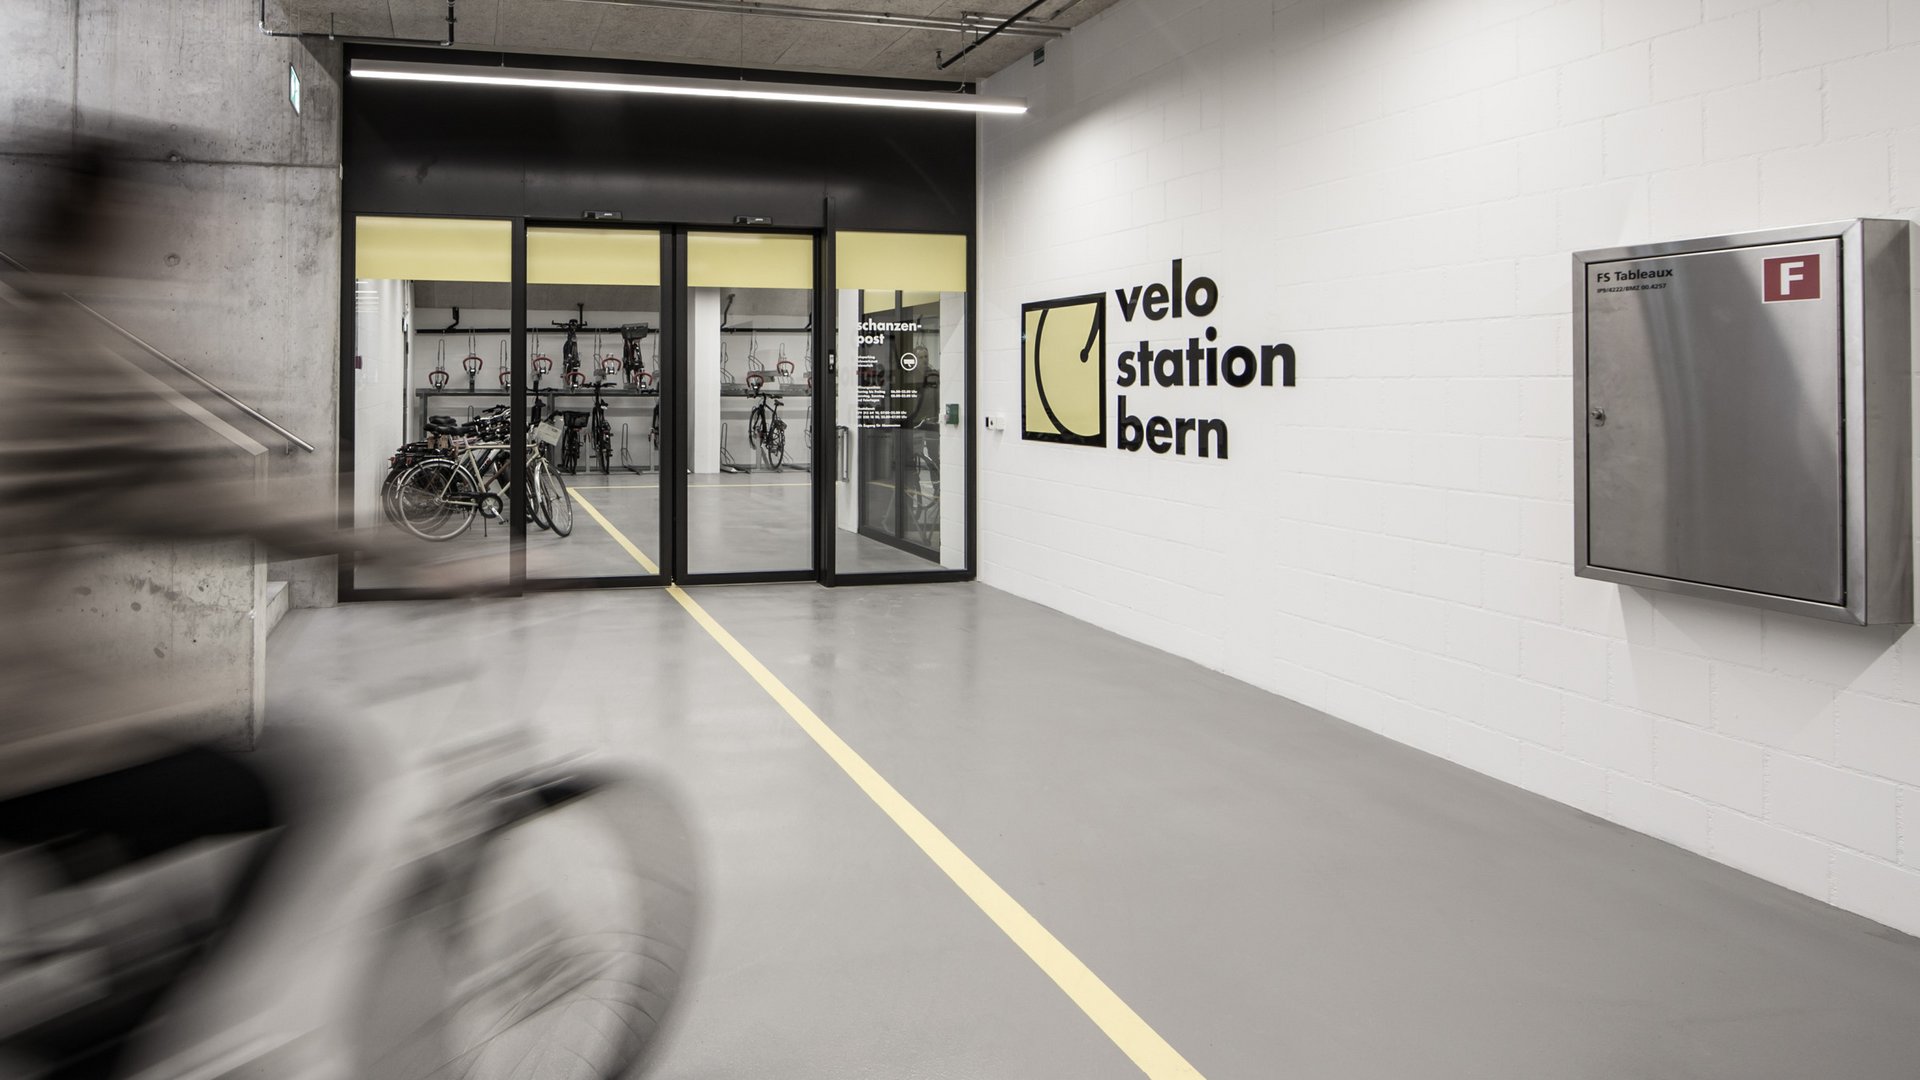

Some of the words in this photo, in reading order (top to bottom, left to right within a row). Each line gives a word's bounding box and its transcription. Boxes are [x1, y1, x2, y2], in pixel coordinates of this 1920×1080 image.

[1115, 258, 1218, 322] velo
[1597, 272, 1611, 283] FS
[1614, 269, 1673, 281] Tableaux
[1780, 261, 1804, 295] F
[857, 318, 922, 331] schanzen-
[1116, 326, 1296, 387] station
[1117, 395, 1228, 459] bern
